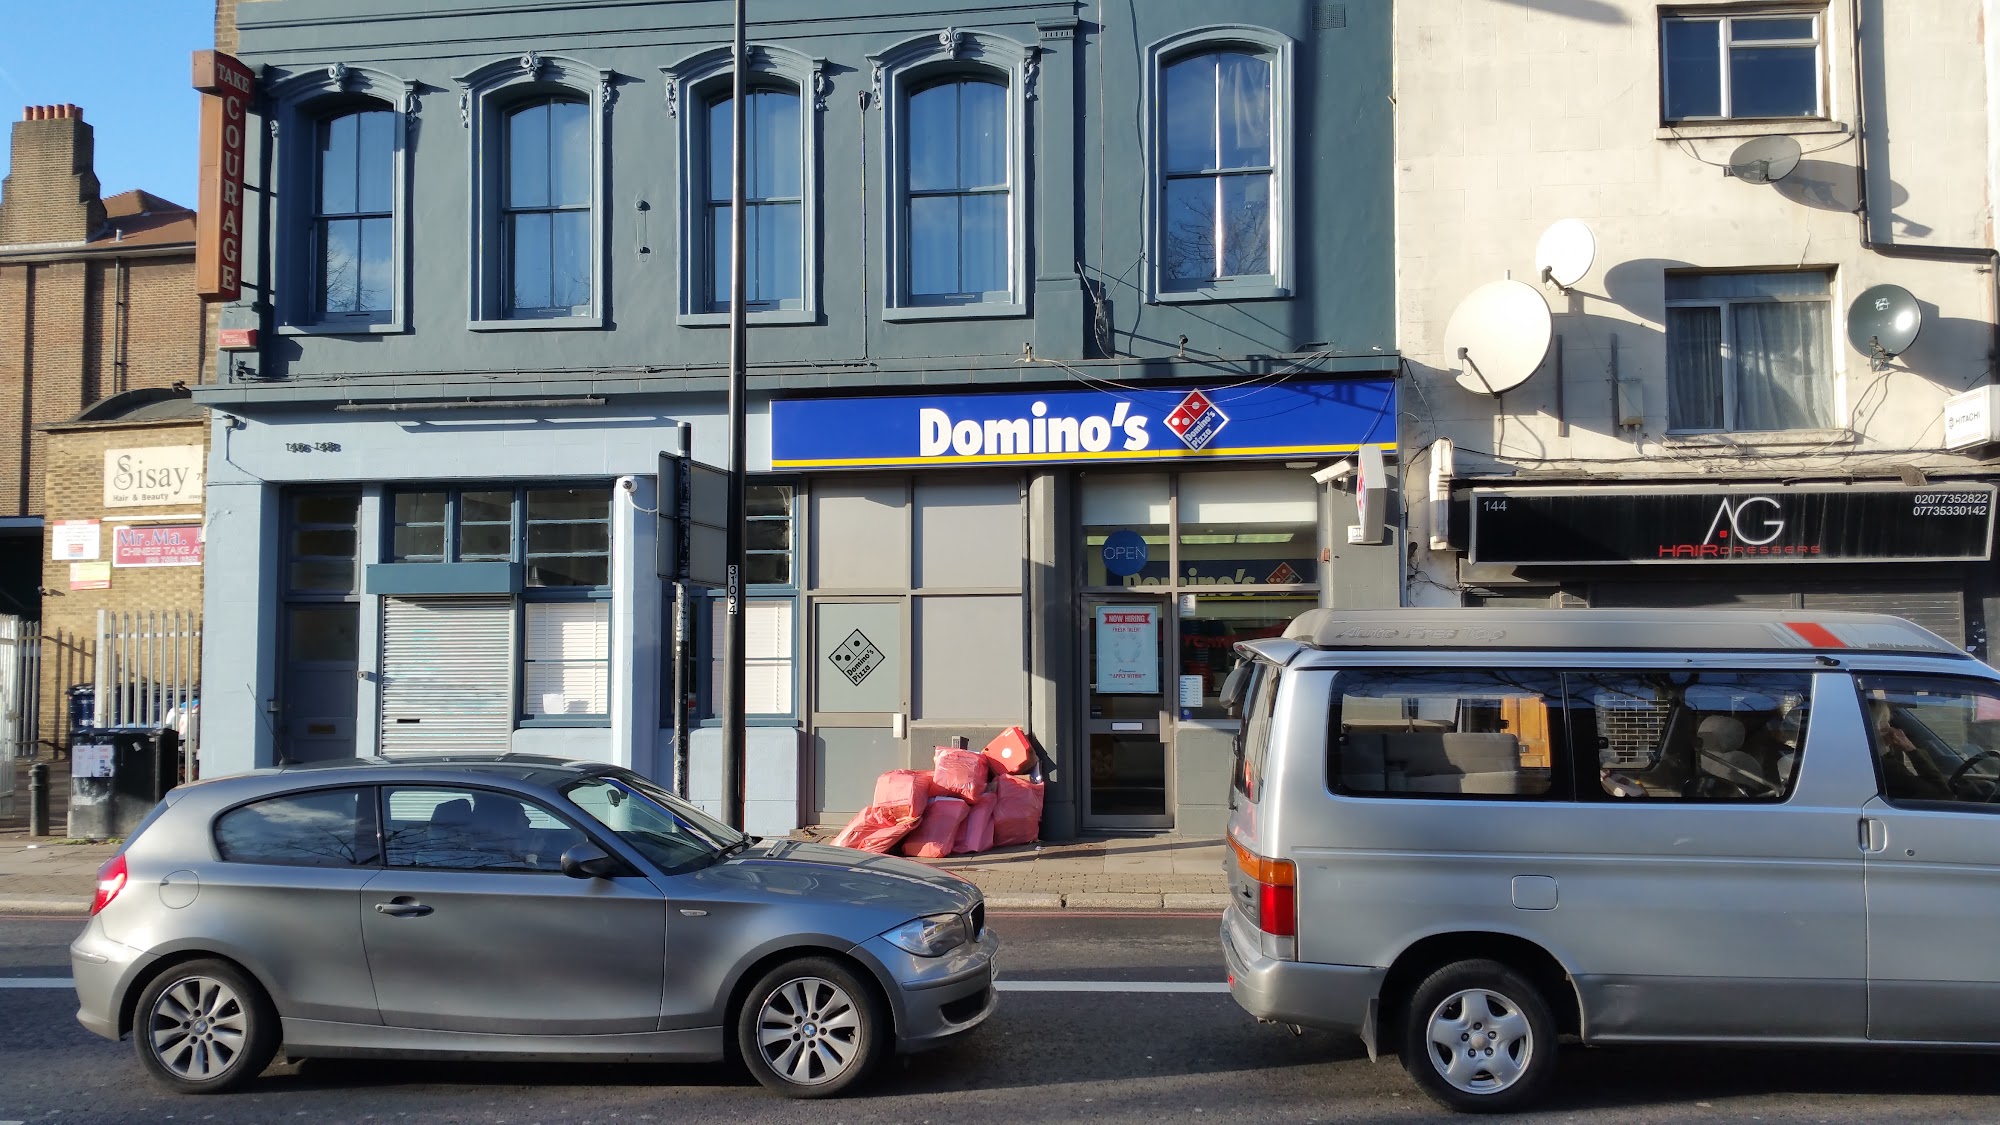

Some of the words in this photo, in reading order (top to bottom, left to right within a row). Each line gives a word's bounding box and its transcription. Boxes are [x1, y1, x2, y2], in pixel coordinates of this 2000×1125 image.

[217, 63, 250, 94] TAKE
[221, 95, 241, 292] COURAGE
[1184, 410, 1216, 442] Domino's
[1955, 411, 1981, 424] HITACHI
[919, 401, 1150, 456] Domino's
[1191, 428, 1213, 449] Pizza
[113, 454, 190, 496] Sisay
[113, 494, 129, 502] Hair
[132, 493, 138, 501] &
[141, 493, 169, 502] Beauty
[1483, 500, 1507, 512] 144
[1914, 493, 1989, 504] 02077352822
[1912, 505, 1987, 516] 07735330142
[1702, 496, 1785, 546] AG
[121, 547, 161, 557] CHINESE
[163, 545, 190, 555] TAKE
[1103, 546, 1147, 560] OPEN
[728, 565, 737, 615] 31004
[1108, 614, 1124, 623] NOW
[1124, 614, 1146, 623] HIRING
[1461, 625, 1508, 642] Top
[846, 648, 875, 677] Domino's
[851, 664, 871, 683] Pizza
